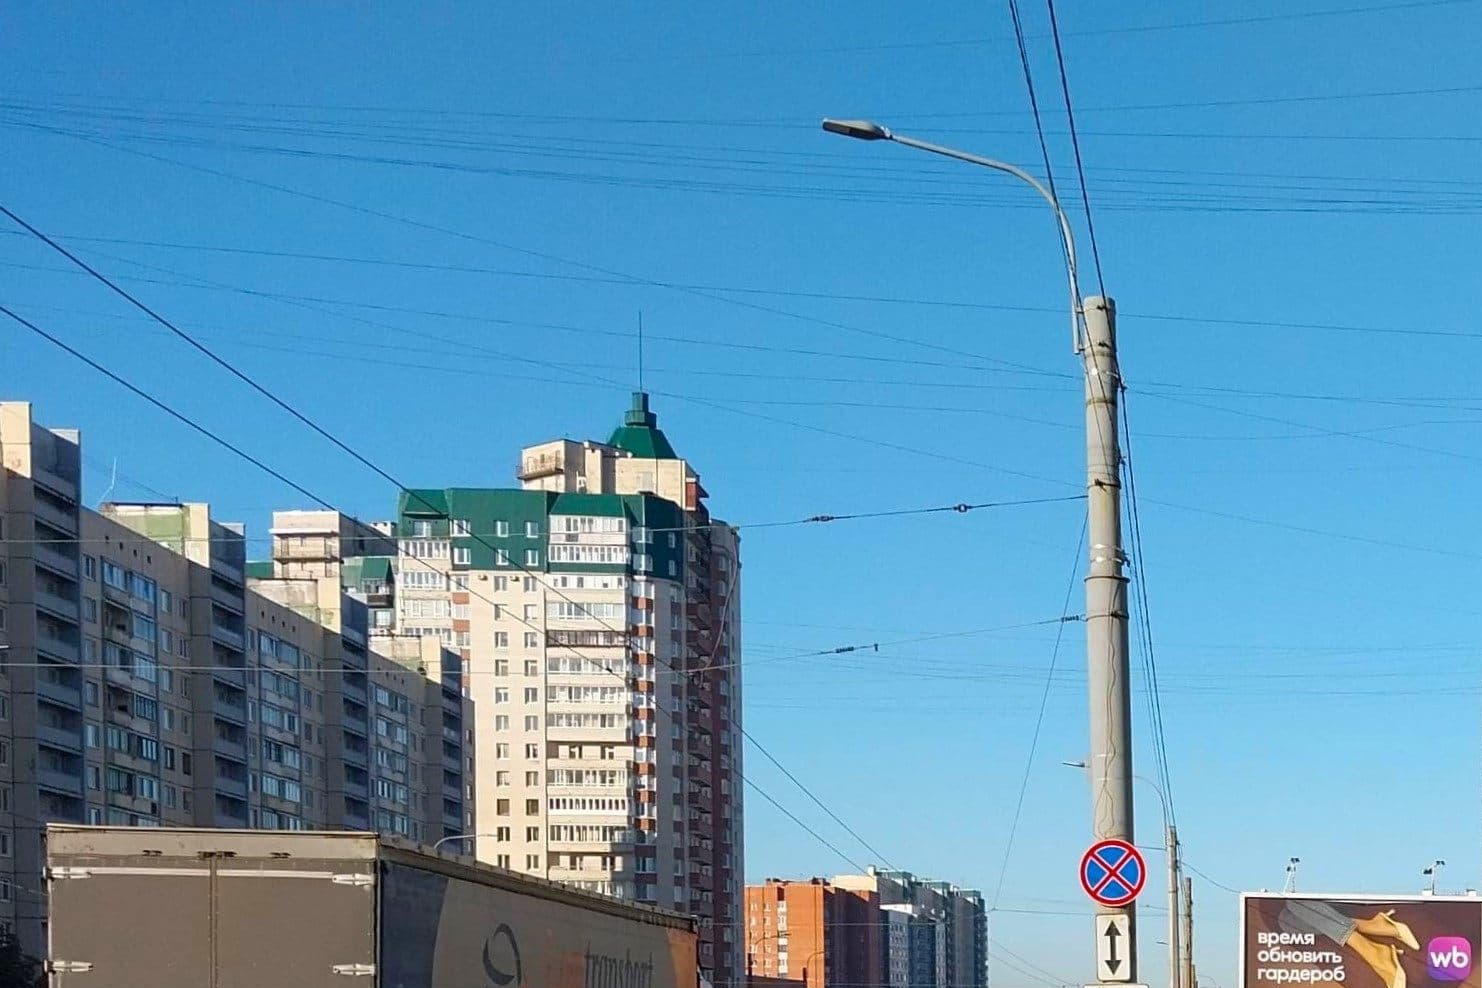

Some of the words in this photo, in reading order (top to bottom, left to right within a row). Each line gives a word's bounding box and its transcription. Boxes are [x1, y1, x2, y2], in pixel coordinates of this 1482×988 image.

[1257, 931, 1315, 947] время
[1257, 948, 1342, 964] обновить
[1430, 949, 1469, 969] wb
[1257, 966, 1346, 984] гардероб
